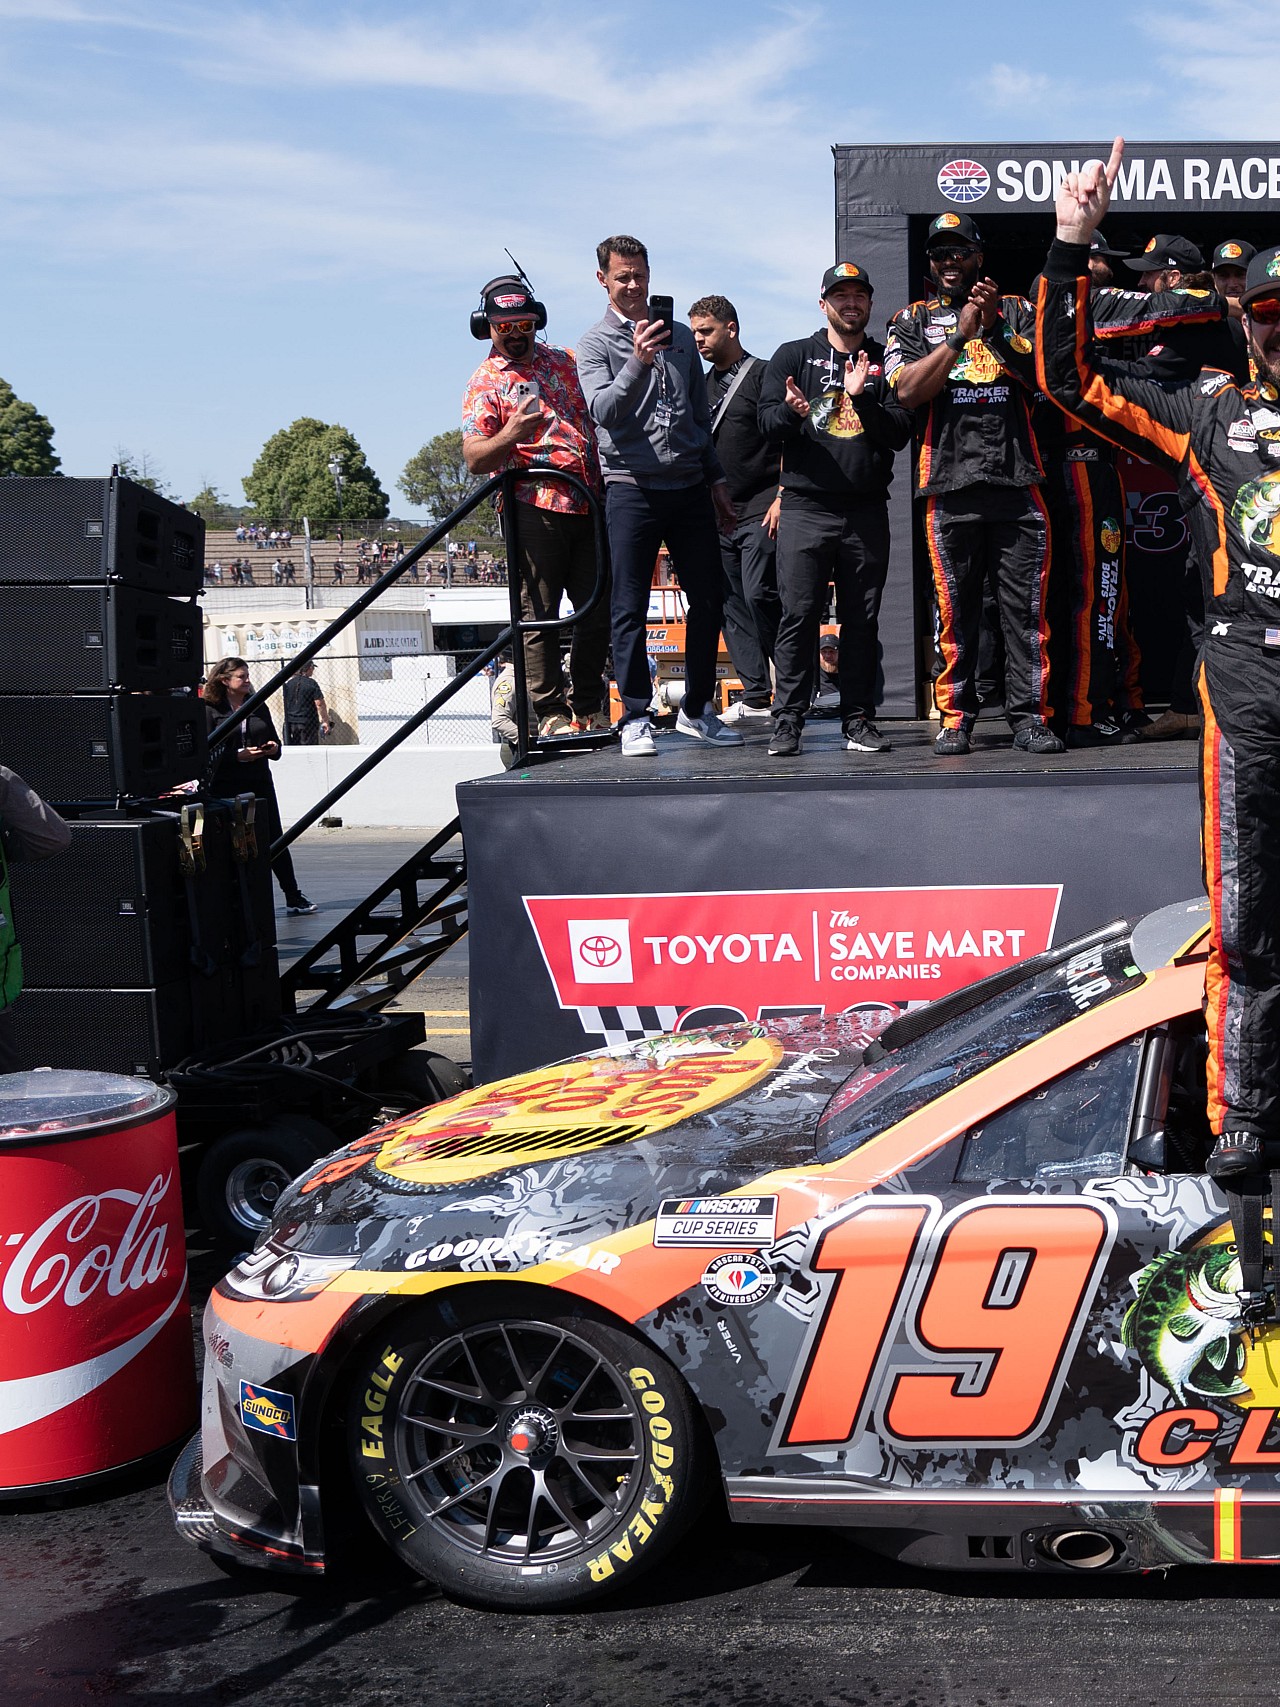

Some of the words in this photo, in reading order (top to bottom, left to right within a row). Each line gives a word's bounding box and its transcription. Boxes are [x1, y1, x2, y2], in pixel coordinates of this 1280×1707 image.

[996, 158, 1176, 202] SONMA
[975, 363, 1000, 375] Shop
[951, 386, 1010, 398] TRACKER
[836, 417, 862, 432] Shop
[1100, 562, 1110, 598] BOATS
[1106, 559, 1120, 650] TRACKER
[829, 909, 859, 929] The
[644, 932, 803, 966] TOYOTA
[830, 931, 915, 961] SAVE
[925, 929, 1026, 959] MART
[830, 963, 942, 982] COMPANIES
[695, 1199, 760, 1215] NASCAR
[672, 1220, 703, 1235] CUP
[706, 1219, 758, 1236] SERIES
[404, 1230, 622, 1275] GOODYEAR
[711, 1255, 744, 1271] NASCAR
[745, 1255, 767, 1271] 75TH
[709, 1285, 768, 1303] ANNIVERSARY
[779, 1202, 1107, 1448] 19
[716, 1319, 742, 1364] VIPER
[245, 1400, 290, 1423] SUNOCO
[361, 1344, 404, 1459] EAGLE
[365, 1473, 388, 1491] 19
[586, 1367, 674, 1583] GOODYEAR
